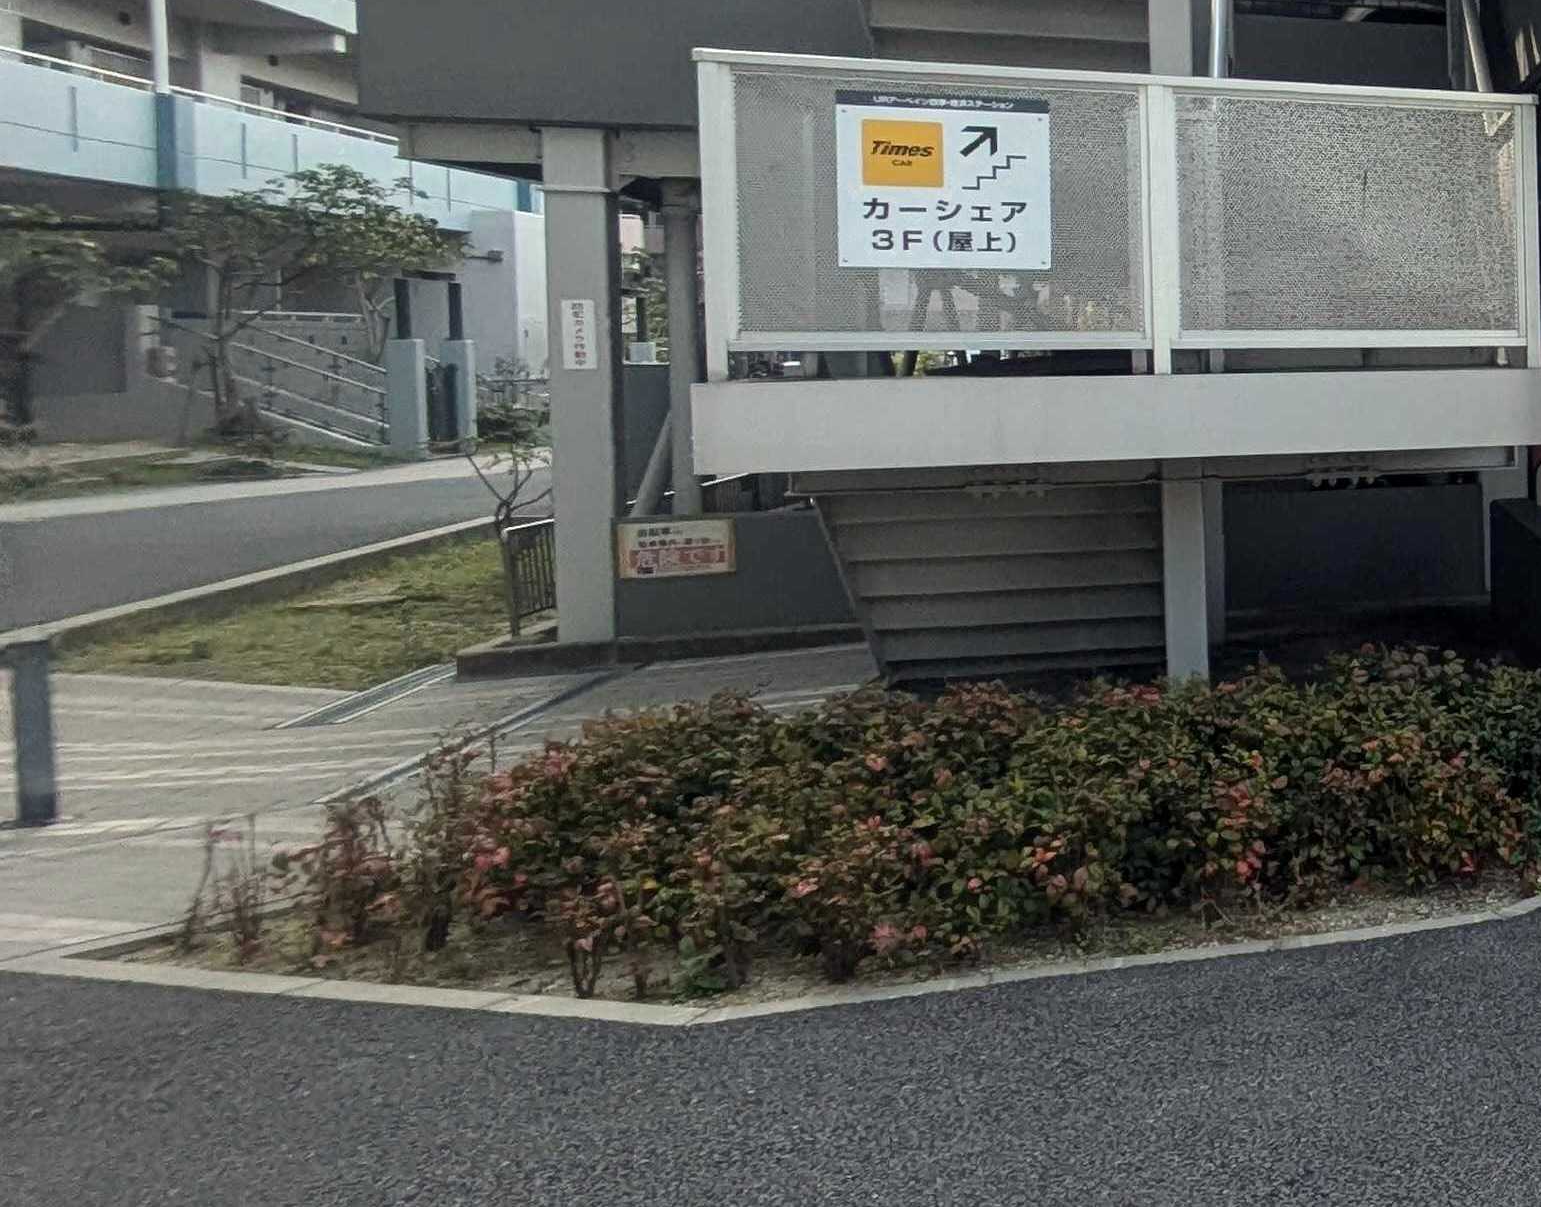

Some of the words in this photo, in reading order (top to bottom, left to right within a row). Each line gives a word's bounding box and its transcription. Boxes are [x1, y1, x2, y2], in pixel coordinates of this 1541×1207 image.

[871, 140, 935, 156] Times
[863, 197, 1027, 222] カーシェア
